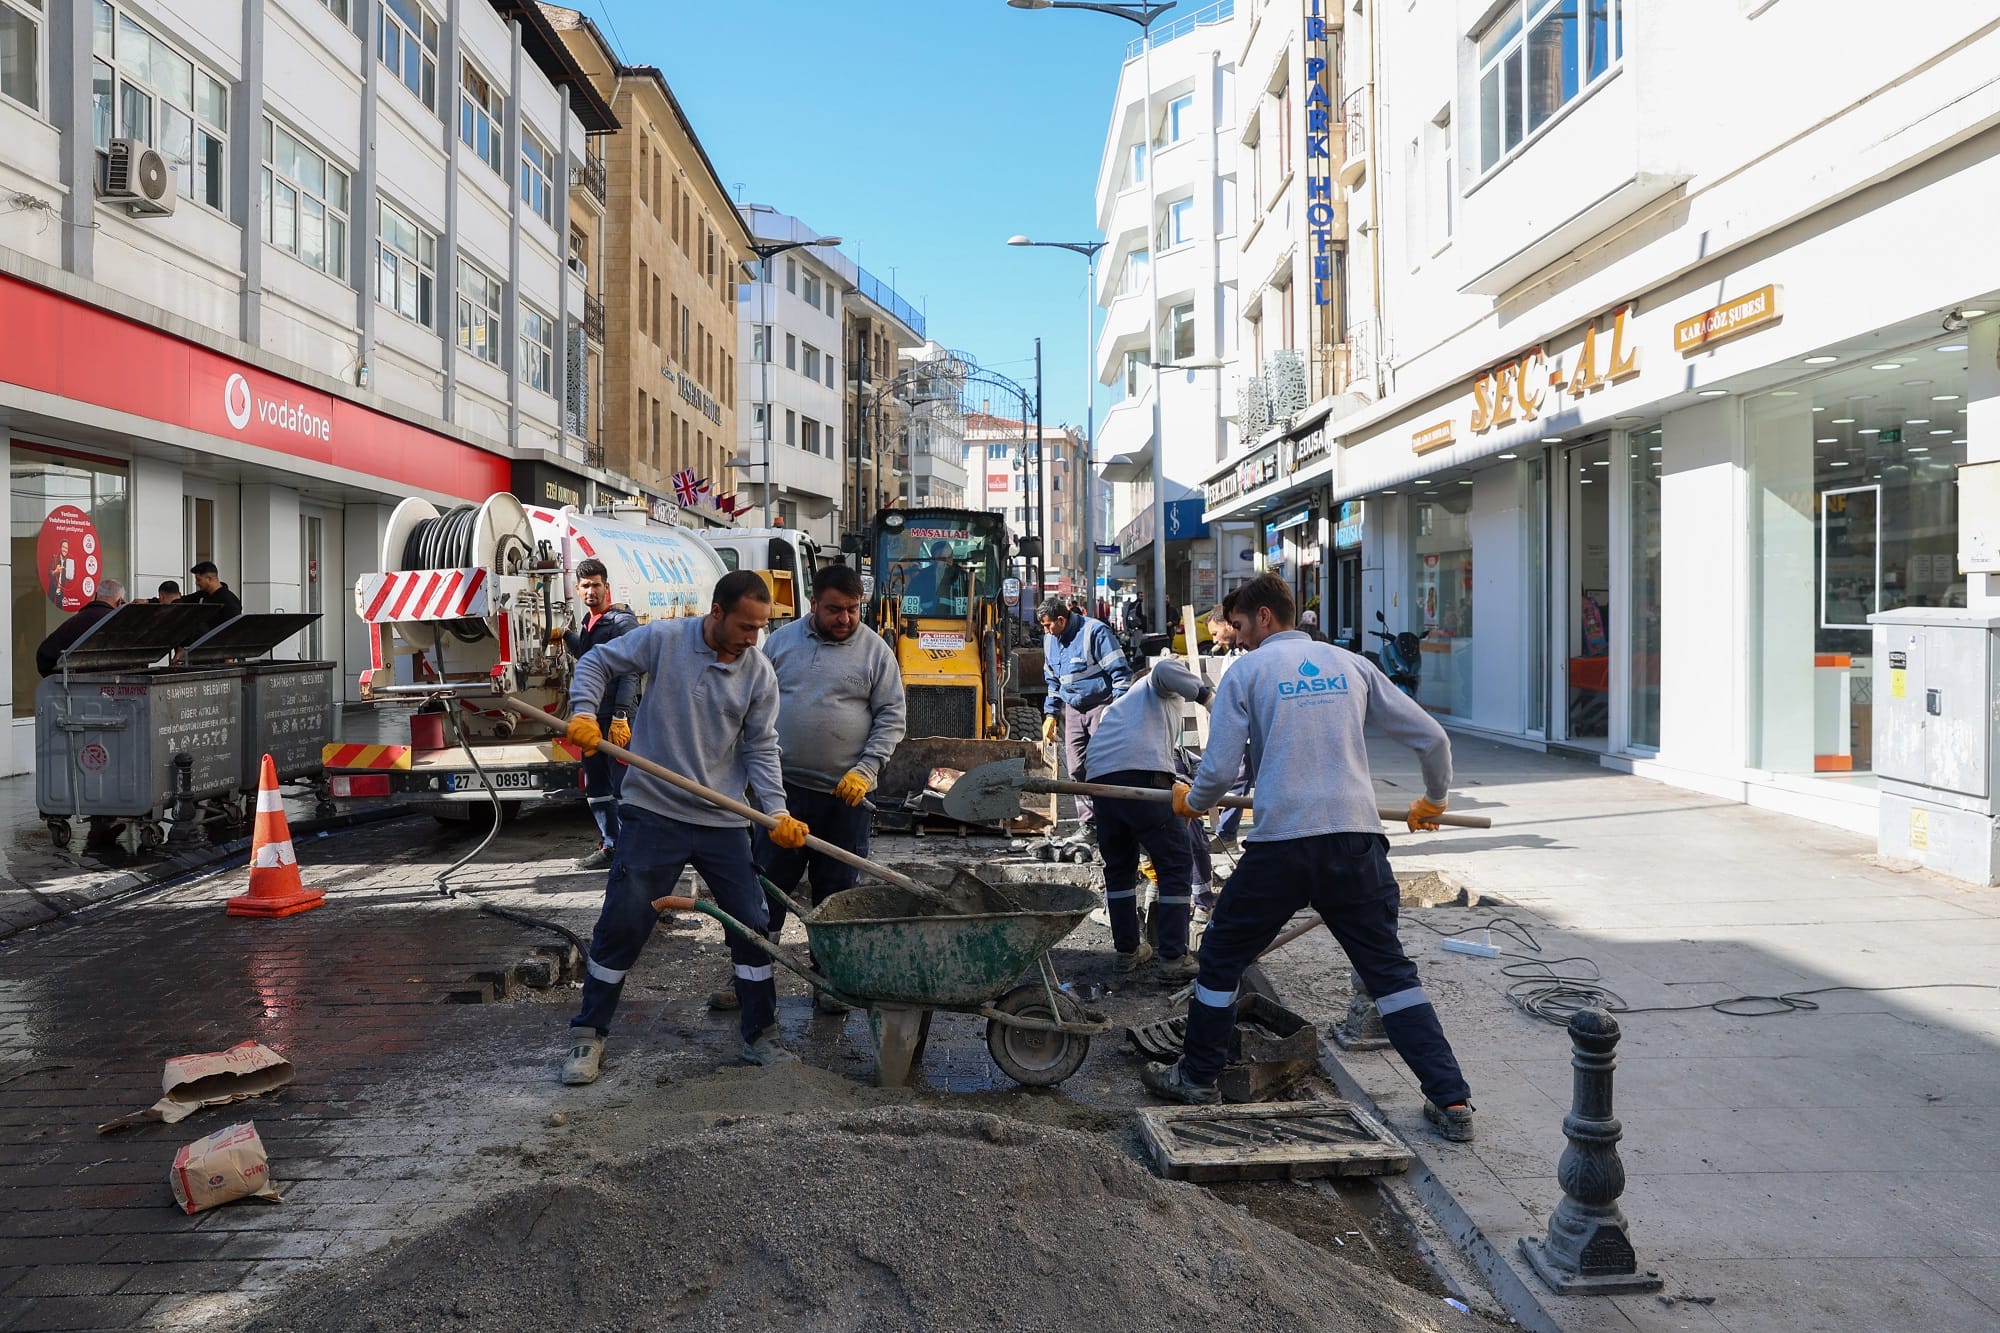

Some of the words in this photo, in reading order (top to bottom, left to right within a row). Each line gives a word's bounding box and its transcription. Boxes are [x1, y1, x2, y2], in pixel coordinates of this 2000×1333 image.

[1305, 57, 1331, 159] PARK
[1306, 176, 1334, 306] HOTEL
[1680, 311, 1728, 344] KARAGÖZ
[1728, 292, 1766, 328] ŞUBESİ
[1470, 303, 1644, 434] SEÇ-AL
[257, 398, 330, 441] vodafone
[911, 528, 970, 540] MAŞALLAH
[1278, 674, 1348, 695] GASKİ
[455, 775, 470, 789] 27
[496, 772, 528, 788] 0893
